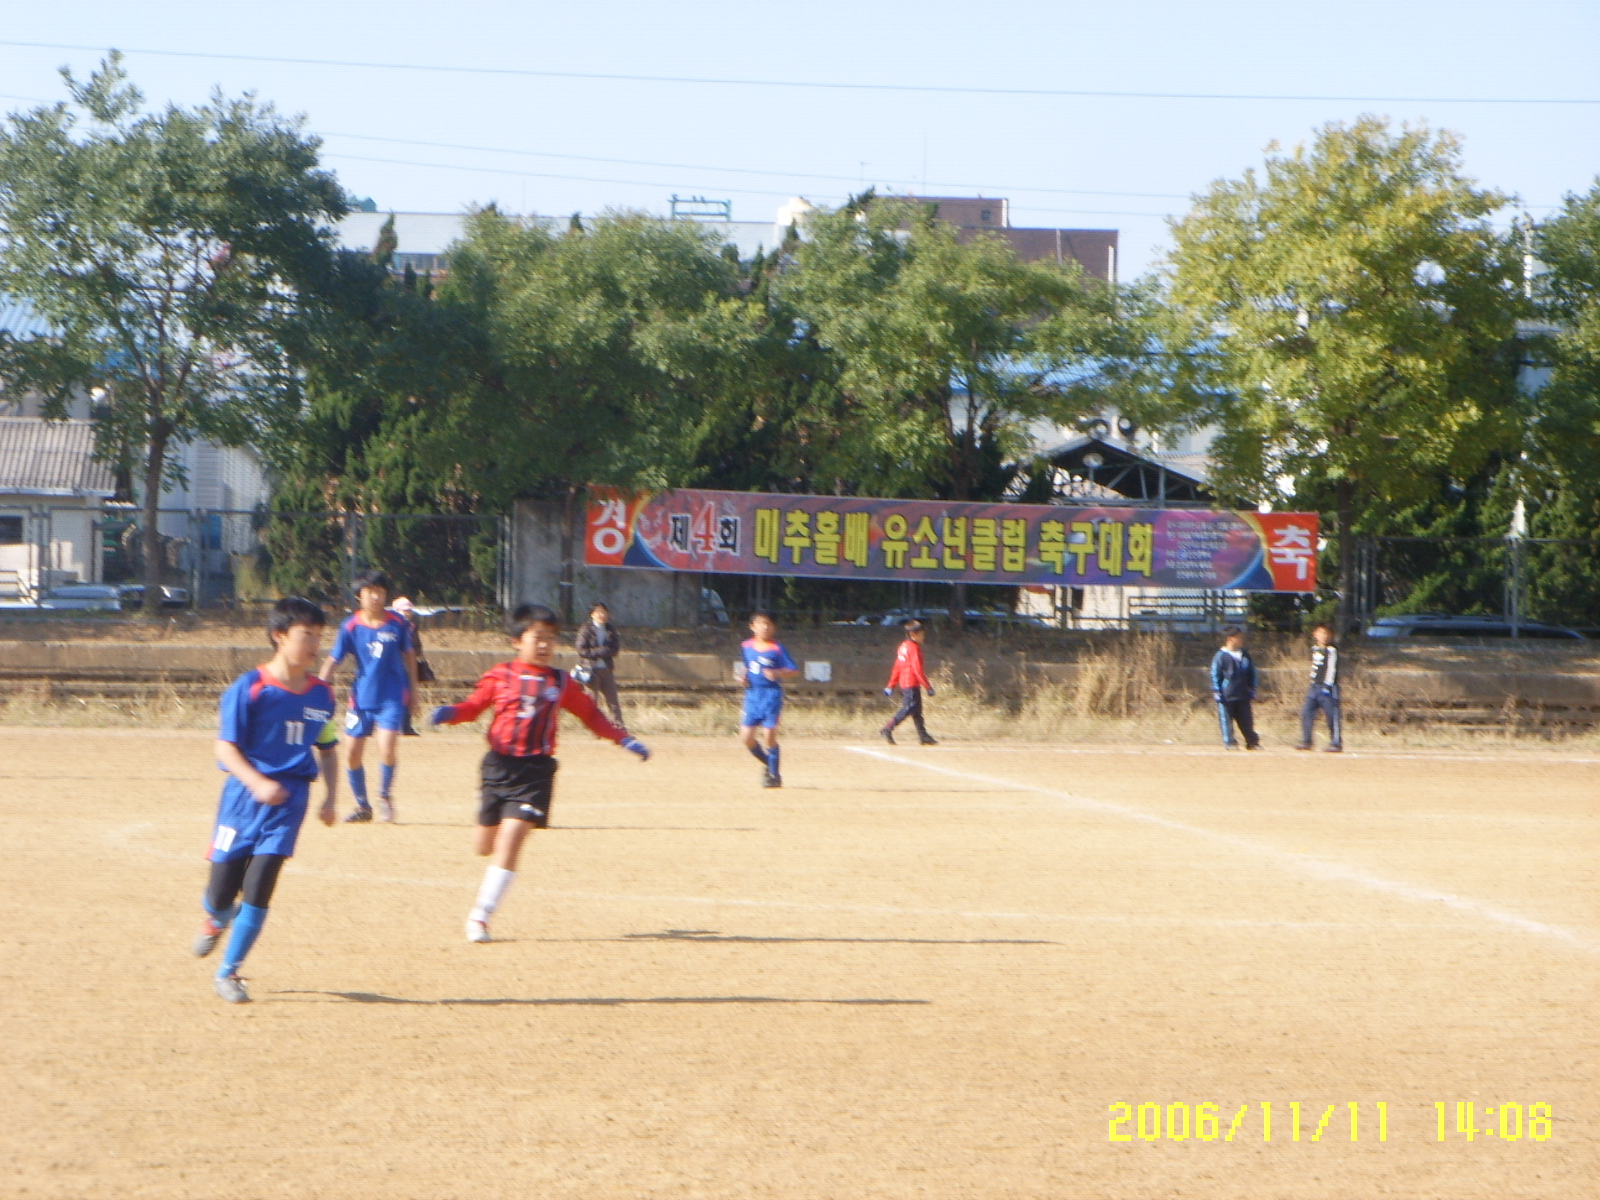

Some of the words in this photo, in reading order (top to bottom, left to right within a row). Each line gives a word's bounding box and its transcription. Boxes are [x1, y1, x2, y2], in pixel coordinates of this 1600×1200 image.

[592, 498, 627, 555] 경
[669, 500, 741, 556] 제4회
[754, 508, 871, 568] 미추홀배
[881, 514, 1027, 573] 유소년클럽
[1038, 519, 1154, 578] 축구대회
[1272, 525, 1313, 580] 축
[285, 720, 305, 745] 11
